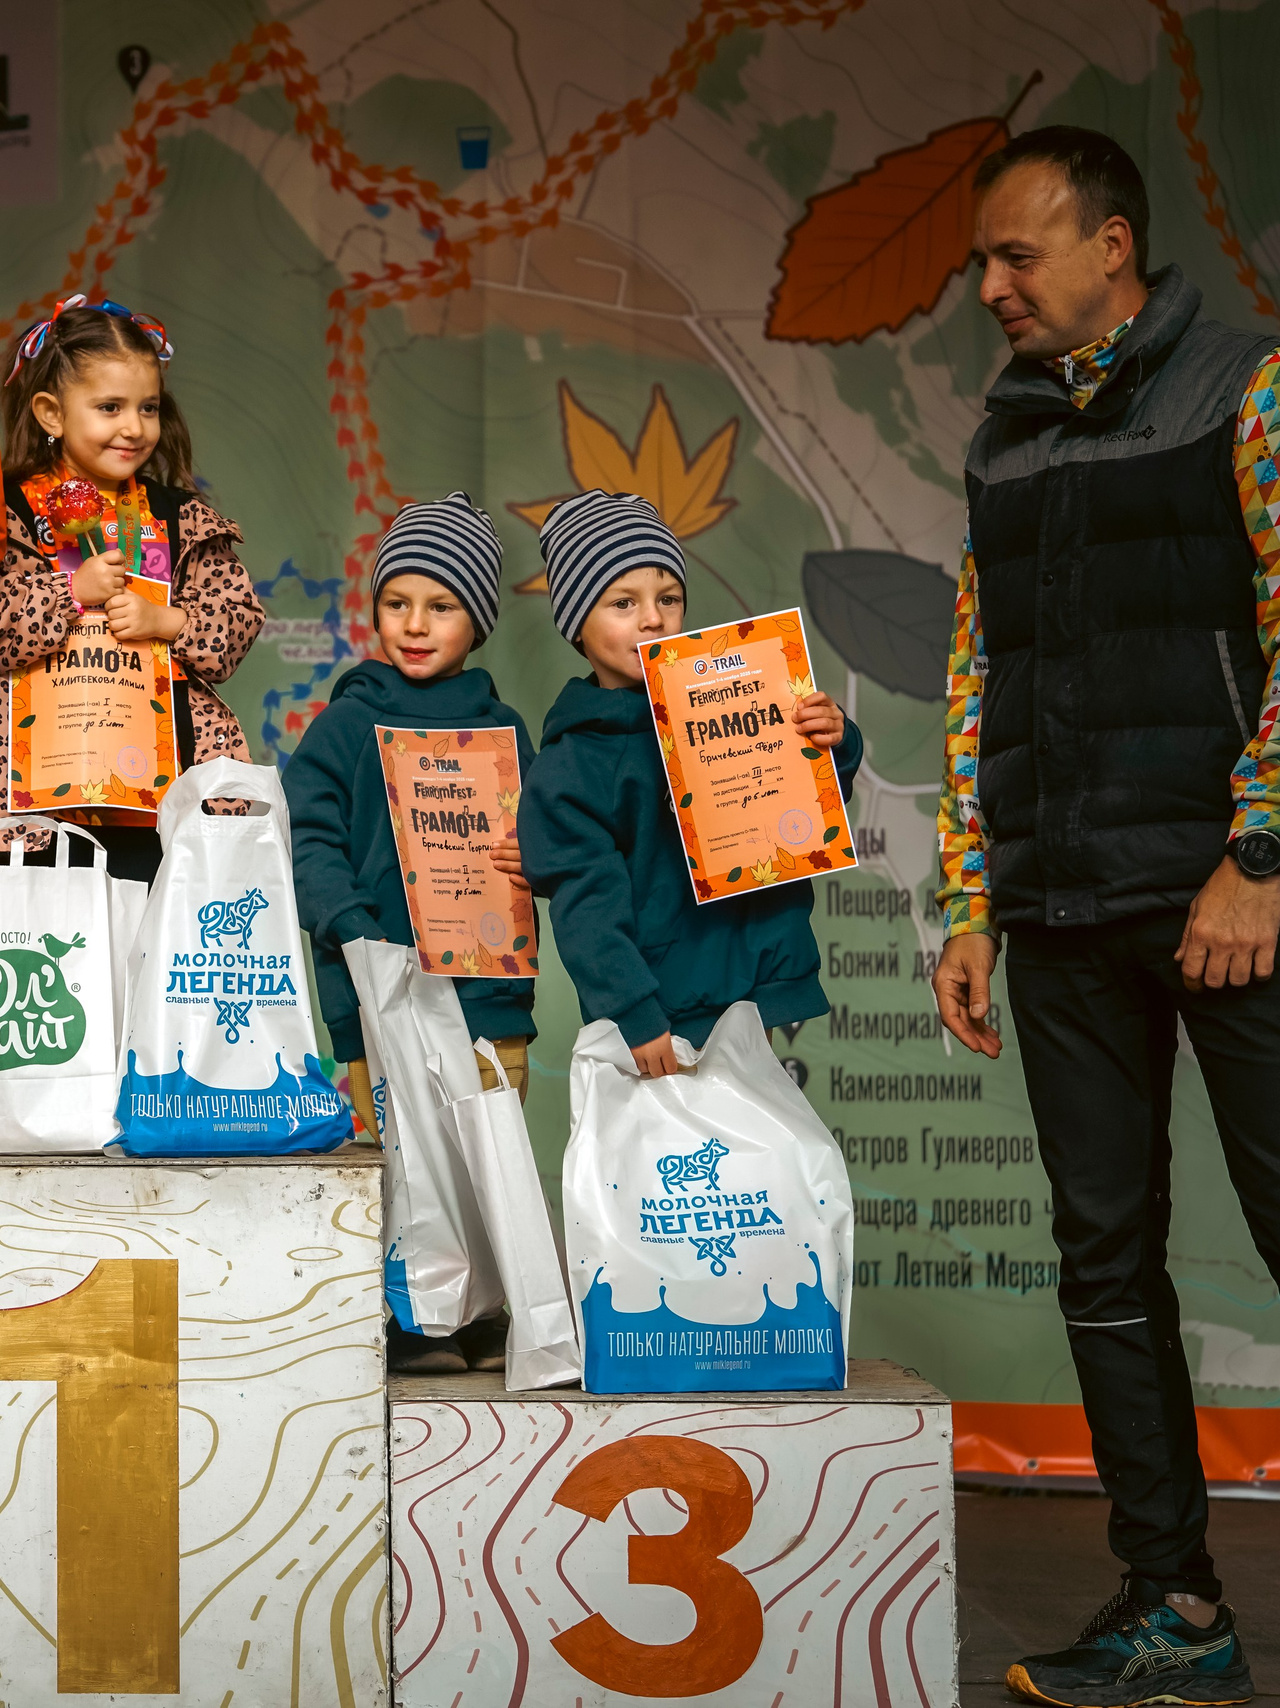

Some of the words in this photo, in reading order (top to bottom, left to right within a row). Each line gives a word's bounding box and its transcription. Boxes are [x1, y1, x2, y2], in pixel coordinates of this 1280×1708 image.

[128, 47, 142, 76] 3
[684, 703, 785, 747] ГРАМОТА
[411, 808, 490, 838] ГРАМОТА
[826, 880, 912, 924] Пещера
[828, 942, 900, 979] Божий
[166, 971, 297, 996] ЛЕГЕНДА
[166, 995, 210, 1005] славные
[256, 998, 297, 1009] времена
[830, 1066, 983, 1102] Каменоломни
[130, 1093, 182, 1119] ТОЛЬКО
[186, 1094, 284, 1119] НАТУРАЛЬНОЕ
[289, 1091, 342, 1118] МОЛОК
[213, 1122, 268, 1134] www.milklegend.ru
[922, 1127, 1034, 1172] Гуливеров
[640, 1206, 783, 1236] ЛЕГЕНДА
[852, 1199, 917, 1233] ещера
[930, 1199, 1031, 1232] древнего
[640, 1235, 685, 1245] славные
[739, 1226, 785, 1239] времена
[894, 1251, 973, 1288] Летней
[608, 1332, 664, 1357] ТОЛЬКО
[670, 1329, 769, 1357] НАТУРАЛЬНОЕ
[775, 1328, 834, 1354] МОЛОКО
[694, 1359, 751, 1371] www.milklegend.ru
[549, 1434, 764, 1698] 3
